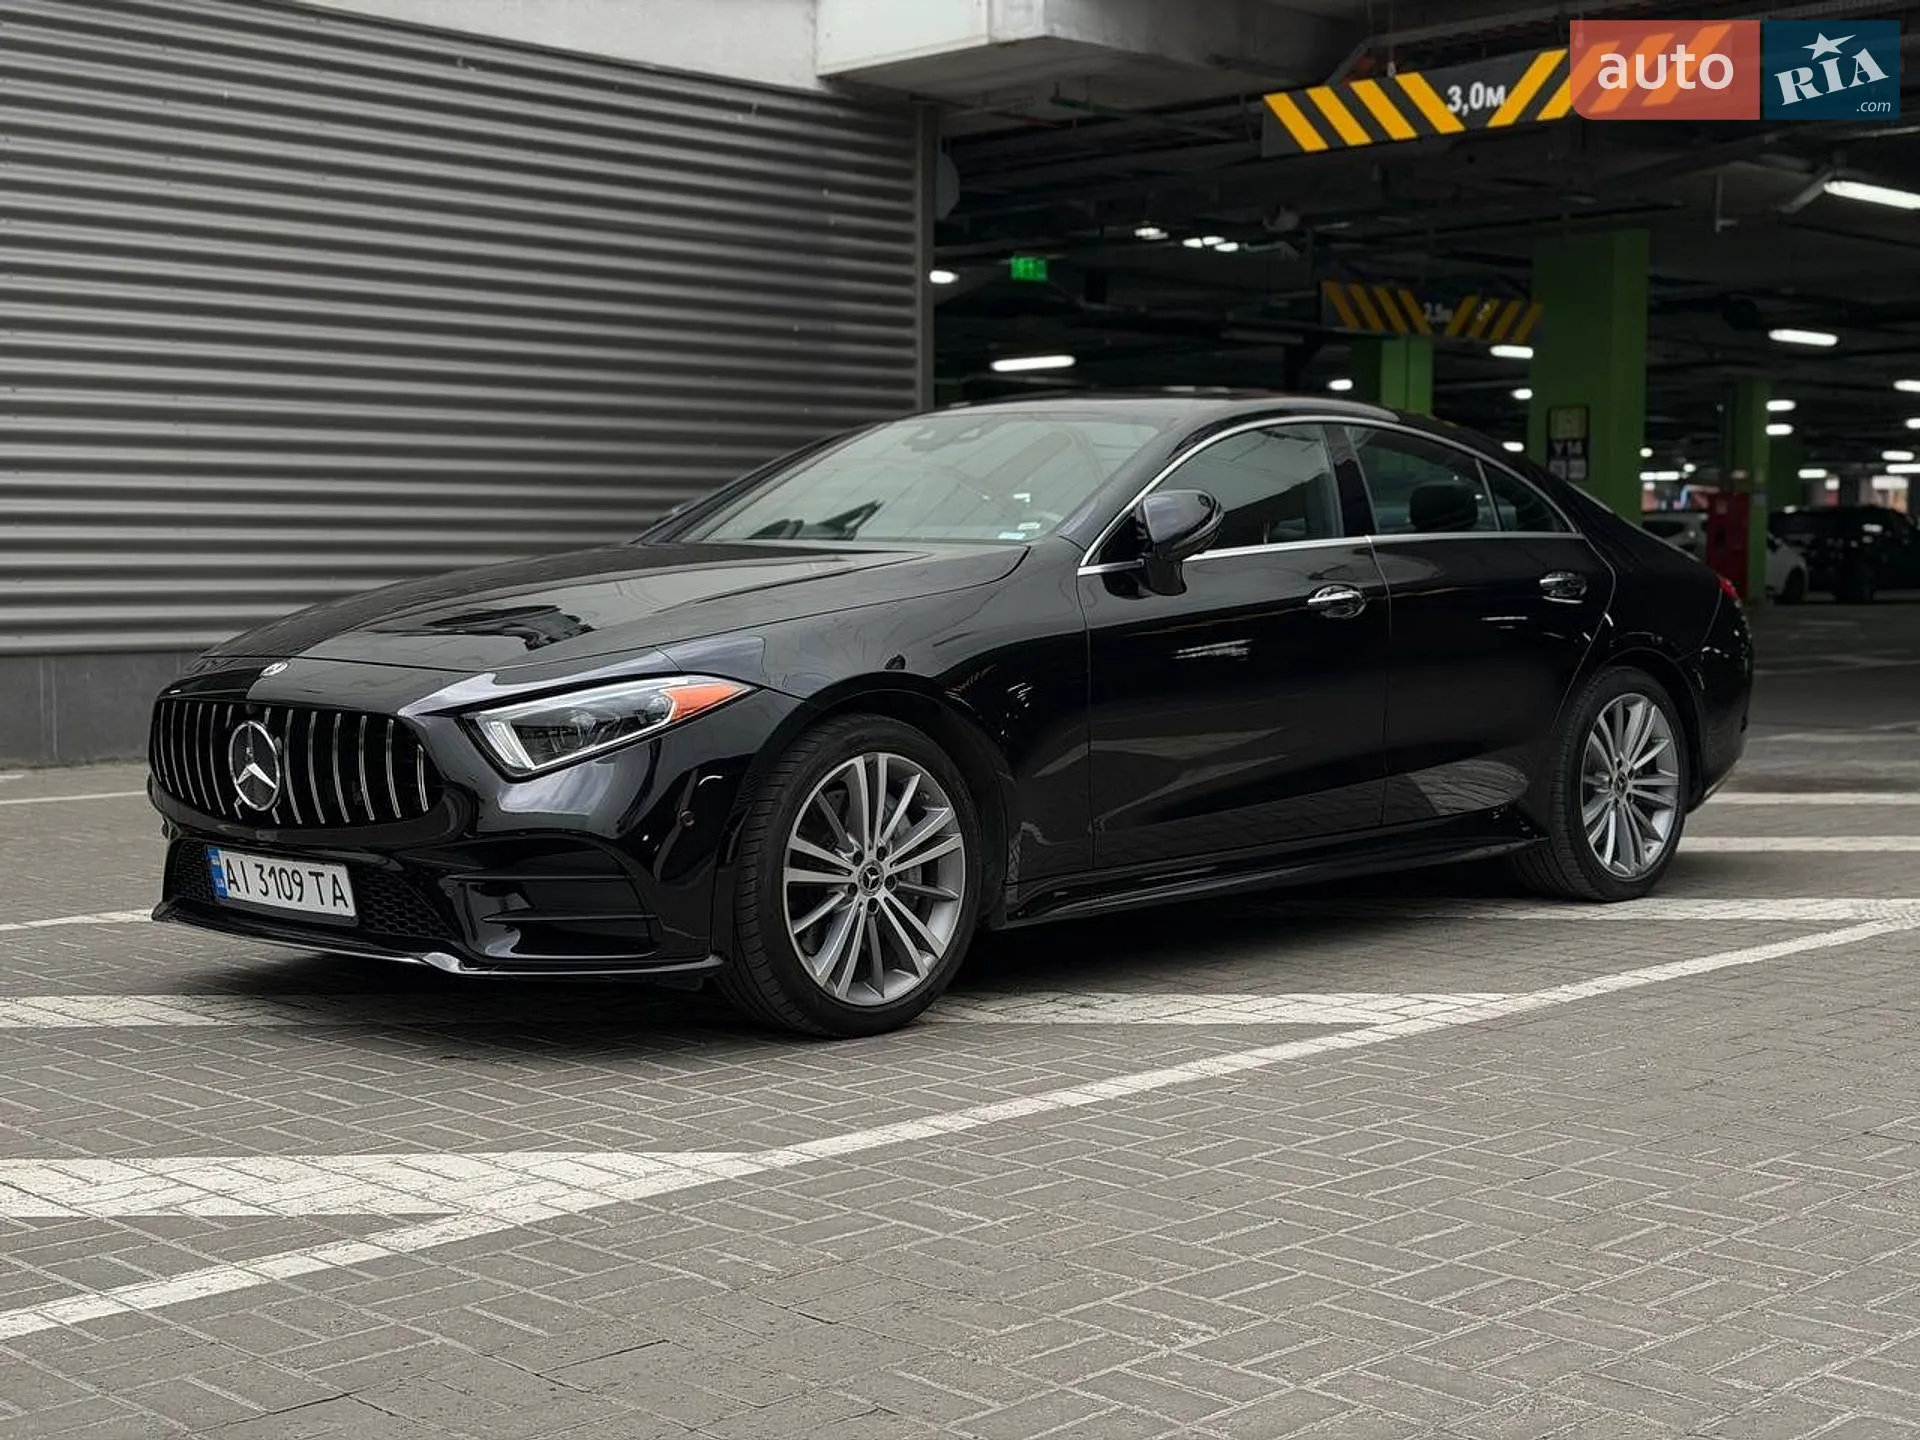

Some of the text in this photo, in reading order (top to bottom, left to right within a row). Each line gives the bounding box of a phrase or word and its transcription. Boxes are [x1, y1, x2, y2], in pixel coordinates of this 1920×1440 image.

[225, 858, 349, 908] AI 3109 TA
